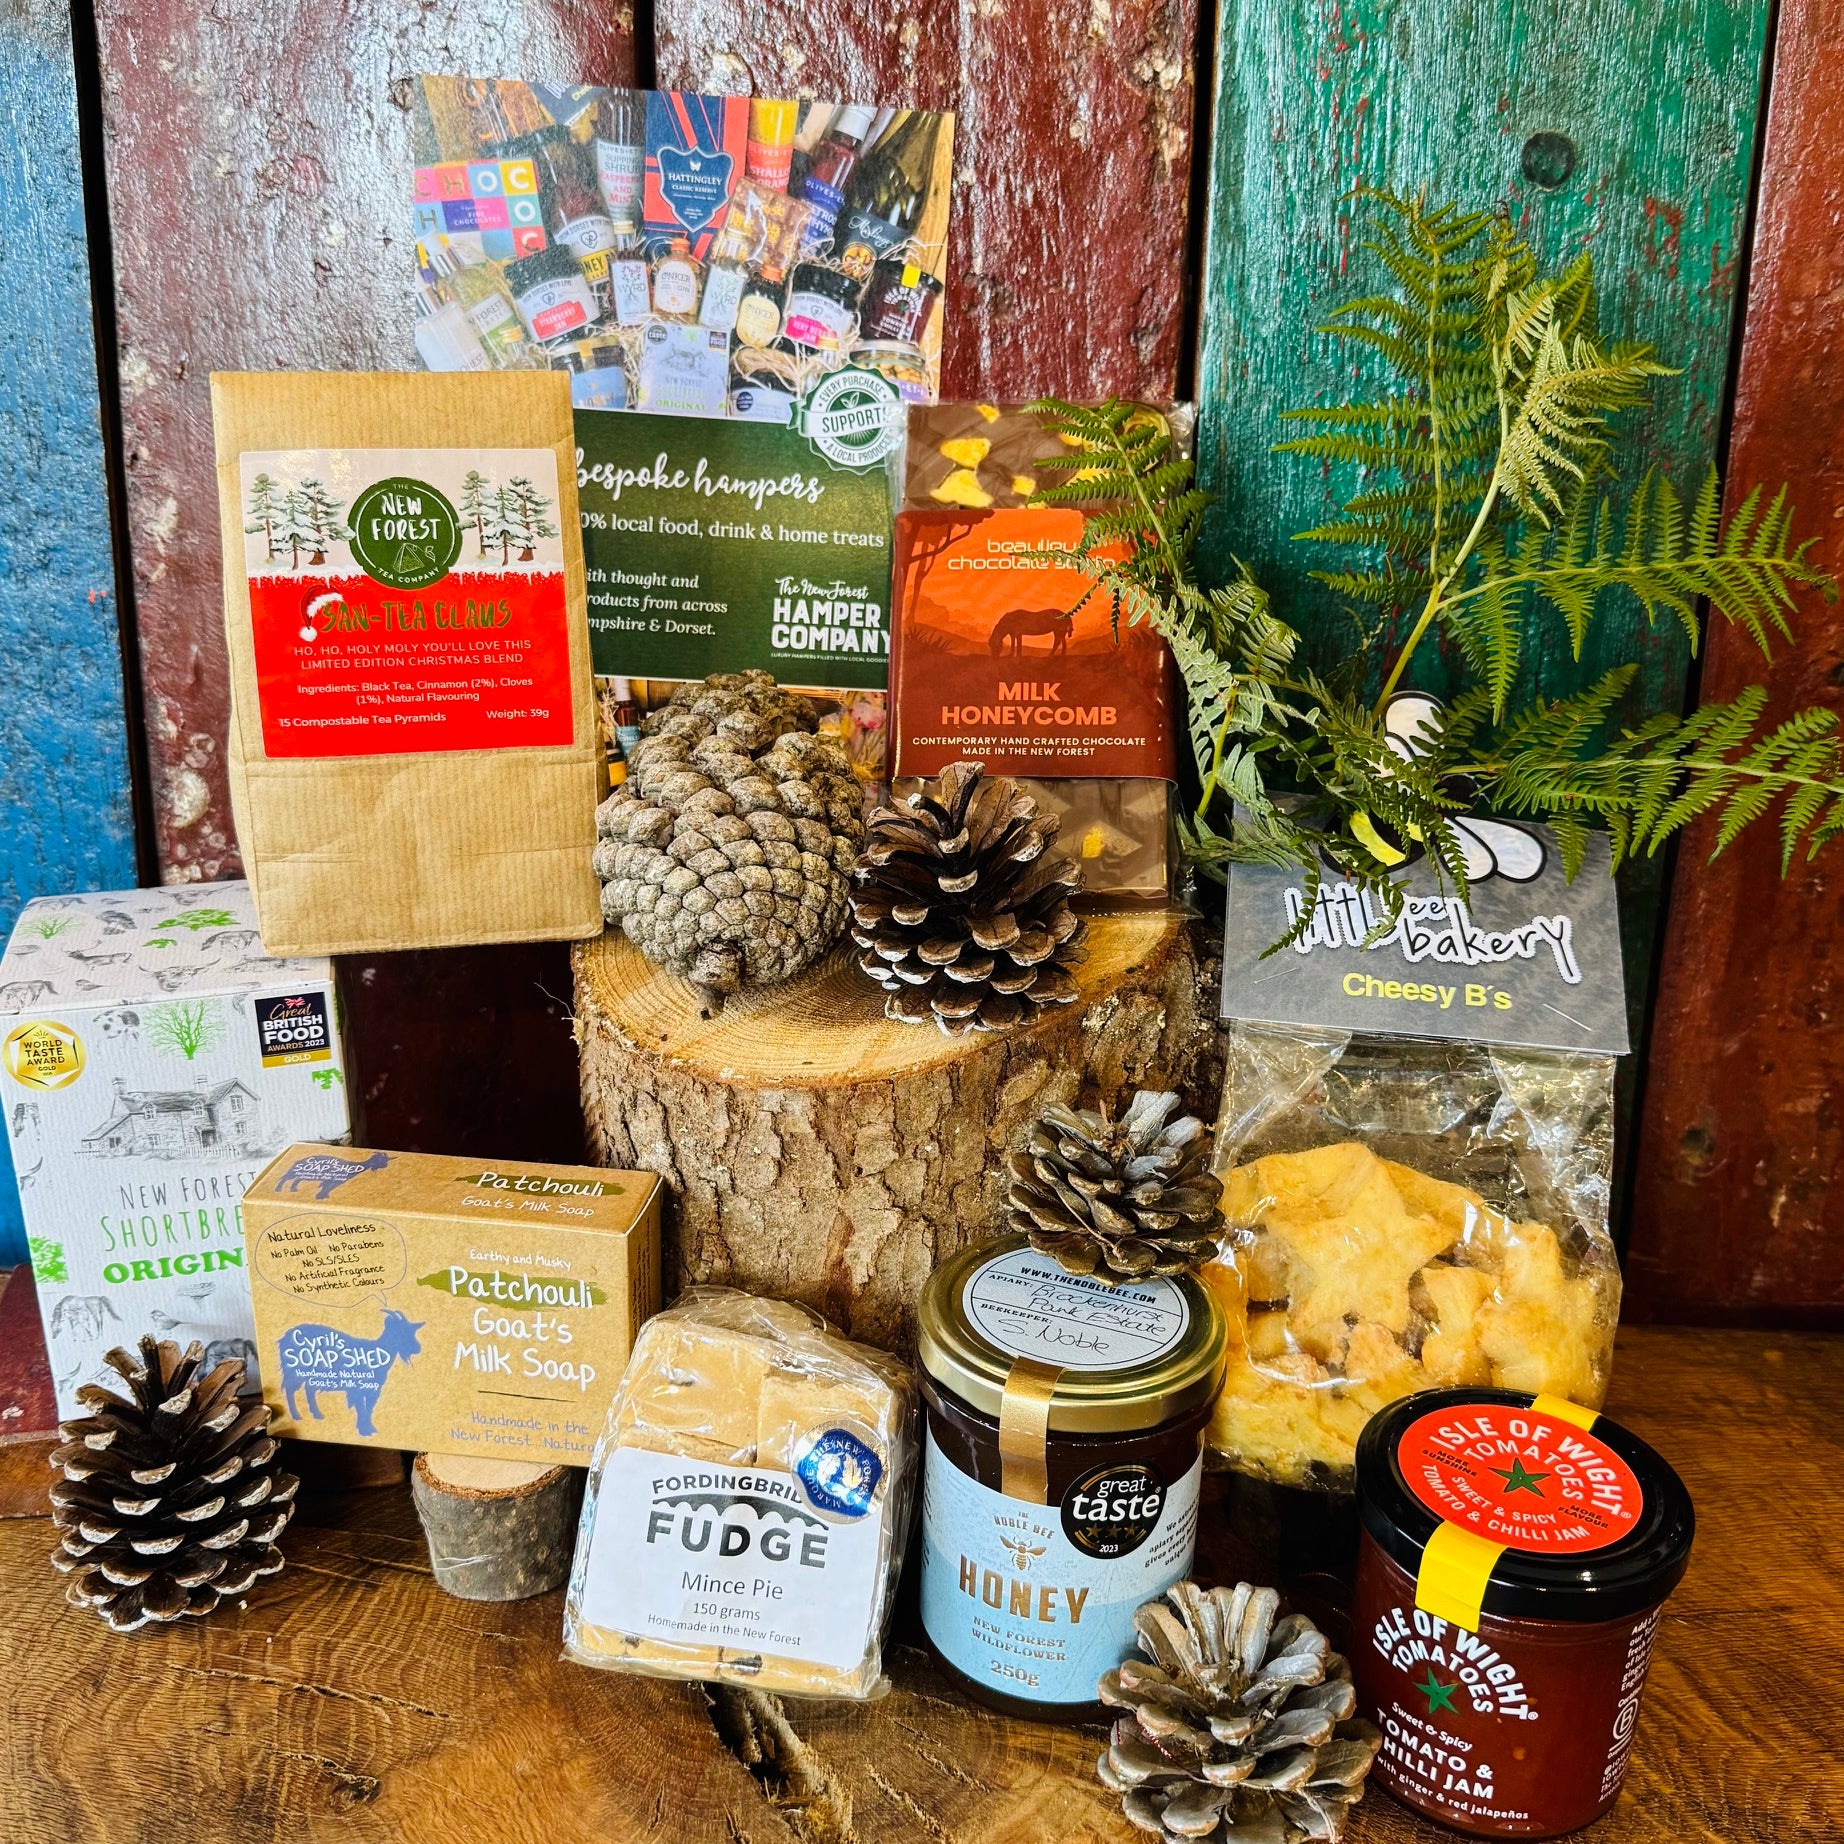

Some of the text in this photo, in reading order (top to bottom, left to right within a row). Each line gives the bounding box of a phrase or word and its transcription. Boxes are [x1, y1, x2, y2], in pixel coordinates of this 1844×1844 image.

[668, 173, 722, 185] HATTINGLEY
[819, 376, 884, 402] EVERY PURCHASE
[694, 457, 825, 511] hampers
[380, 493, 422, 516] NEW
[371, 518, 441, 541] FOREST
[611, 514, 653, 533] local
[658, 518, 703, 539] food,
[708, 522, 756, 540] drink
[760, 528, 774, 540] &
[779, 526, 828, 544] home
[833, 530, 884, 547] treats
[987, 539, 1077, 553] beaulieu
[948, 556, 1048, 570] chocolate
[377, 567, 441, 584] TEA COMPANY
[641, 595, 678, 613] from
[682, 601, 728, 613] across
[772, 598, 881, 628] HAMPER
[320, 600, 513, 633] SAN-TEA CLAUS
[301, 653, 523, 670] LIMITED EDITION CHRISTMAS BLEND
[297, 682, 360, 694] Ingredients:
[362, 681, 390, 692] Black
[393, 681, 414, 692] Tea,
[417, 678, 468, 690] Cinnamon
[500, 677, 533, 687] Cloves
[998, 682, 1061, 701] MILK
[279, 712, 446, 728] 15 Compostable Tea Pyramids
[486, 708, 550, 719] Weight: 39g
[942, 706, 1117, 726] HONEYCOMB
[912, 736, 1146, 746] CONTEMPORARY HAND CRAFTED CHOCOLATE
[962, 747, 1095, 756] MADE IN THE NEW FOREST
[1403, 903, 1574, 978] bakery
[1342, 972, 1456, 1009] Cheesy
[262, 1014, 323, 1031] BRITISH
[270, 1003, 312, 1020] Great
[23, 1040, 62, 1048] WORLD
[265, 1026, 324, 1044] FOOD
[268, 1039, 325, 1052] AWARDS 2023
[25, 1048, 63, 1057] TASTE
[27, 1057, 65, 1065] AWARD
[285, 1054, 311, 1063] GOLD
[476, 1171, 604, 1198] Patchouli
[120, 1183, 167, 1210] NEW
[267, 1223, 376, 1243] Natural Loveliness
[469, 1249, 572, 1270] Earthy and Musky
[285, 1265, 386, 1282] No Artificial Fragrance
[988, 1274, 1034, 1288] APIARY:
[293, 1277, 385, 1294] No Synthetic Colours
[449, 1266, 592, 1309] Patchouli
[1020, 1266, 1157, 1305] WWW.THENOBLEBEE.COM
[980, 1303, 1053, 1325] BEEKEEPER:
[473, 1307, 573, 1345] Goat's
[293, 1329, 345, 1351] Cyril's
[284, 1347, 391, 1368] SOAP SHED
[453, 1342, 596, 1392] Milk Soap
[1421, 1449, 1478, 1477] SUNSHINE
[1429, 1416, 1623, 1516] ISLE OF WIGHT
[1463, 1439, 1585, 1501] TOMATOES
[1099, 1475, 1147, 1498] great
[1072, 1493, 1160, 1522] taste
[1421, 1463, 1590, 1541] TOMATO & CHILLI JAM
[994, 1514, 1055, 1541] NOBLE BEE
[1557, 1506, 1609, 1529] FLAVOUR
[646, 1510, 829, 1569] FUDGE
[1099, 1544, 1119, 1553] 2023
[681, 1570, 784, 1601] Mince Pie
[958, 1553, 1090, 1624] HONEY
[693, 1602, 761, 1621] 150 grams
[973, 1615, 1066, 1648] NEW FOREST
[971, 1628, 1066, 1661] WILDFLOWER
[990, 1659, 1040, 1688] 250g
[1372, 1607, 1529, 1721] ISLE OF WIGHT
[1391, 1639, 1494, 1714] TOMATOES
[1391, 1701, 1473, 1752] Sweet & Spicy
[1376, 1707, 1494, 1780] TOMATO &
[1377, 1755, 1529, 1820] with ginger & red jalapeños
[1443, 1773, 1495, 1800] JAM
